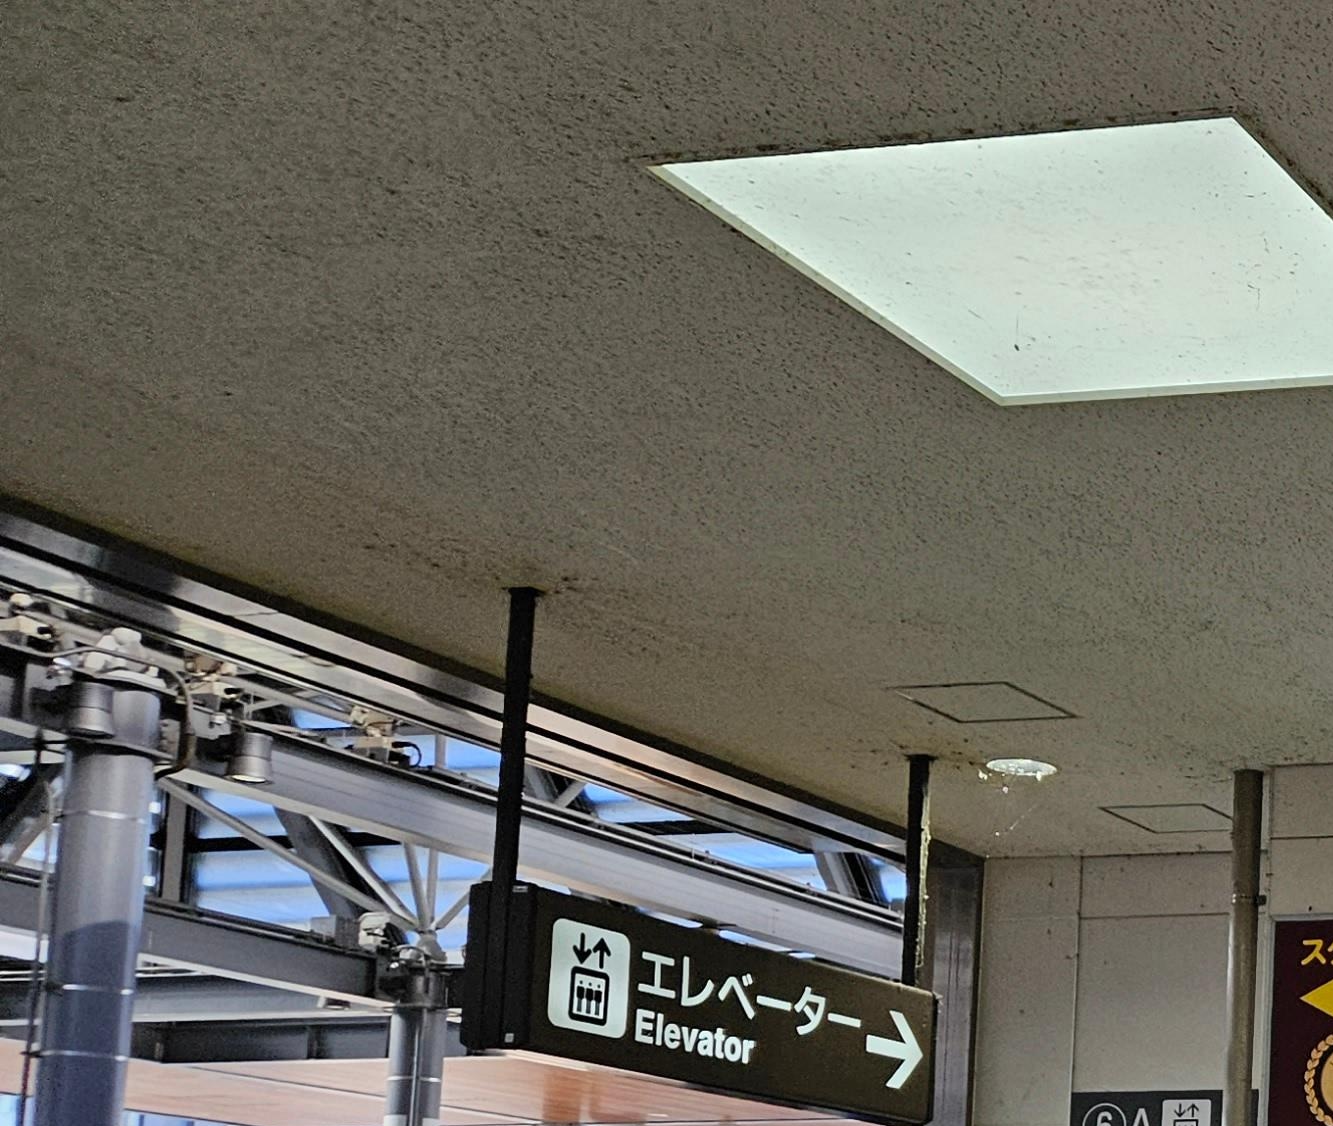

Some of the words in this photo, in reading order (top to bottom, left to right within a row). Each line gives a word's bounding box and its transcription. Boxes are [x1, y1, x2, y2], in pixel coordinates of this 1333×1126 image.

[637, 951, 861, 1036] エレベーター
[634, 1009, 757, 1065] Elevator
